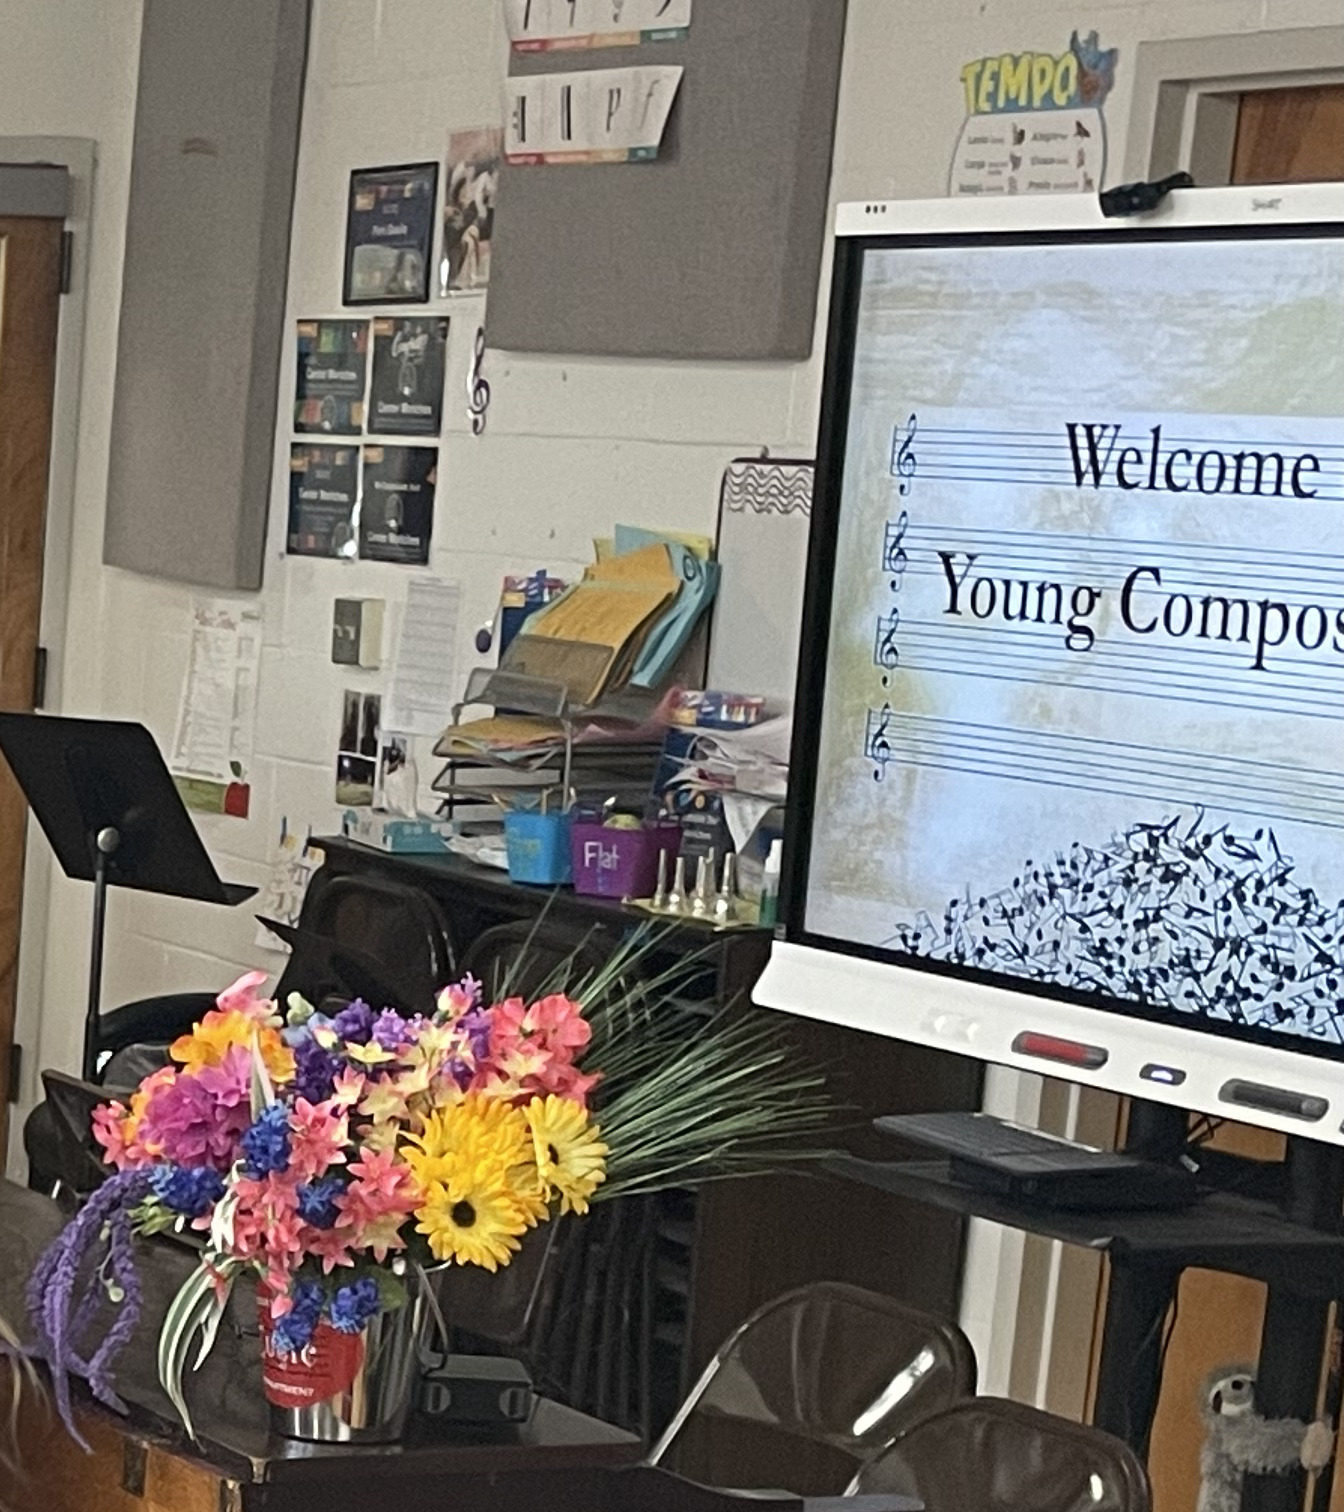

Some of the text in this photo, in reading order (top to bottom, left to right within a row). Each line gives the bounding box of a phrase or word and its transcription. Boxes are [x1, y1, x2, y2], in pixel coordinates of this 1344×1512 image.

[962, 51, 1078, 116] TEMPO
[1065, 421, 1322, 500] Welcome
[937, 550, 1103, 653] Young
[584, 841, 620, 871] Flat
